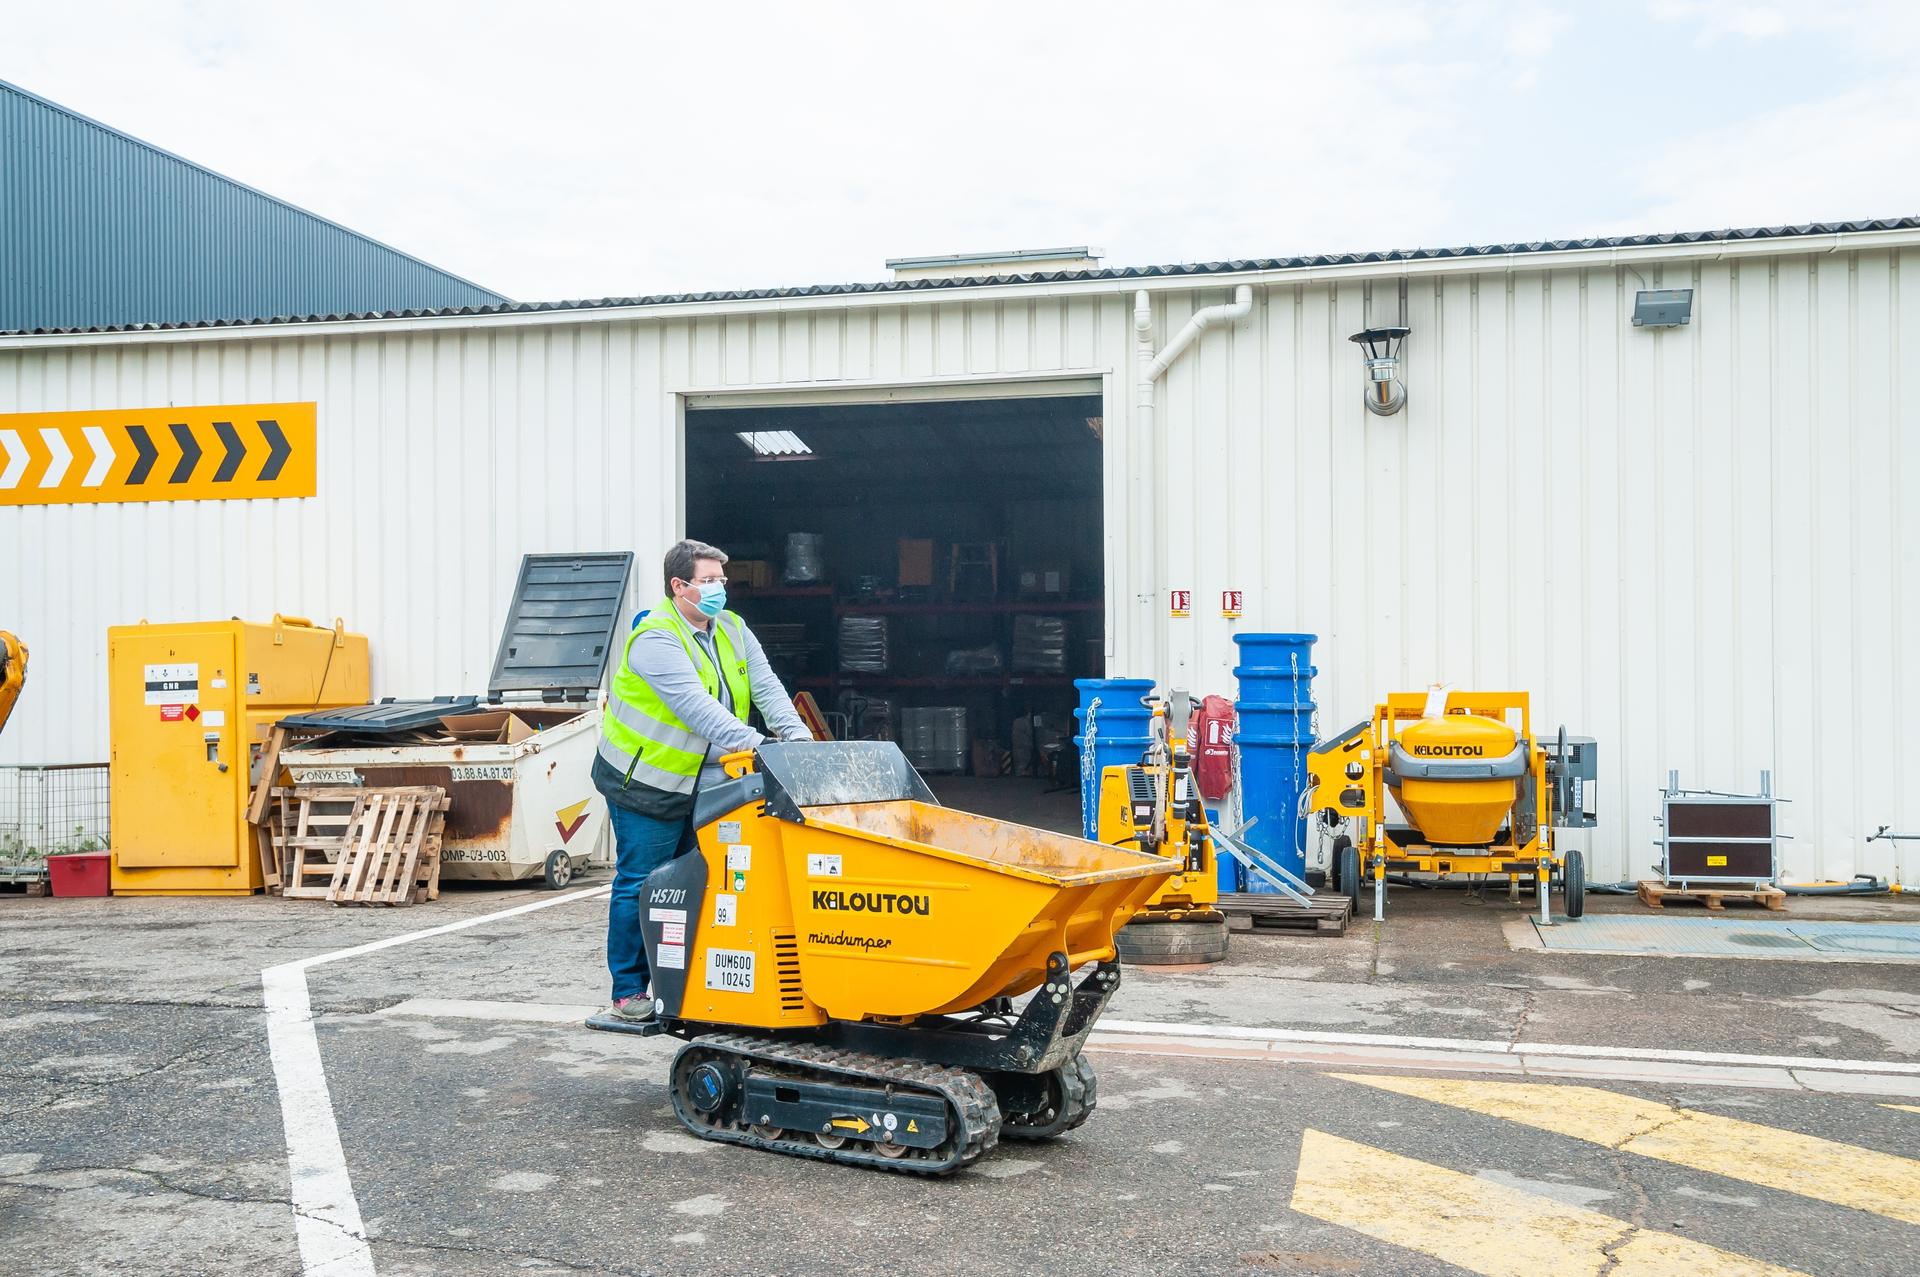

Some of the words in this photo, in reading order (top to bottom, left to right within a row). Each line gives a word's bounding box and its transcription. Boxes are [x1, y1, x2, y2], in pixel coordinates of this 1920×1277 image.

[163, 682, 180, 690] GNR
[1414, 745, 1483, 756] KILOUTOU
[306, 770, 334, 780] ONYX
[335, 770, 352, 780] EST
[451, 767, 513, 780] 03.88.64.87.87
[649, 889, 687, 904] HS701
[812, 890, 930, 916] KILOUTOU
[717, 908, 727, 923] 99
[808, 930, 892, 953] minidumper
[715, 953, 752, 970] DUM600
[721, 971, 751, 988] 10245
